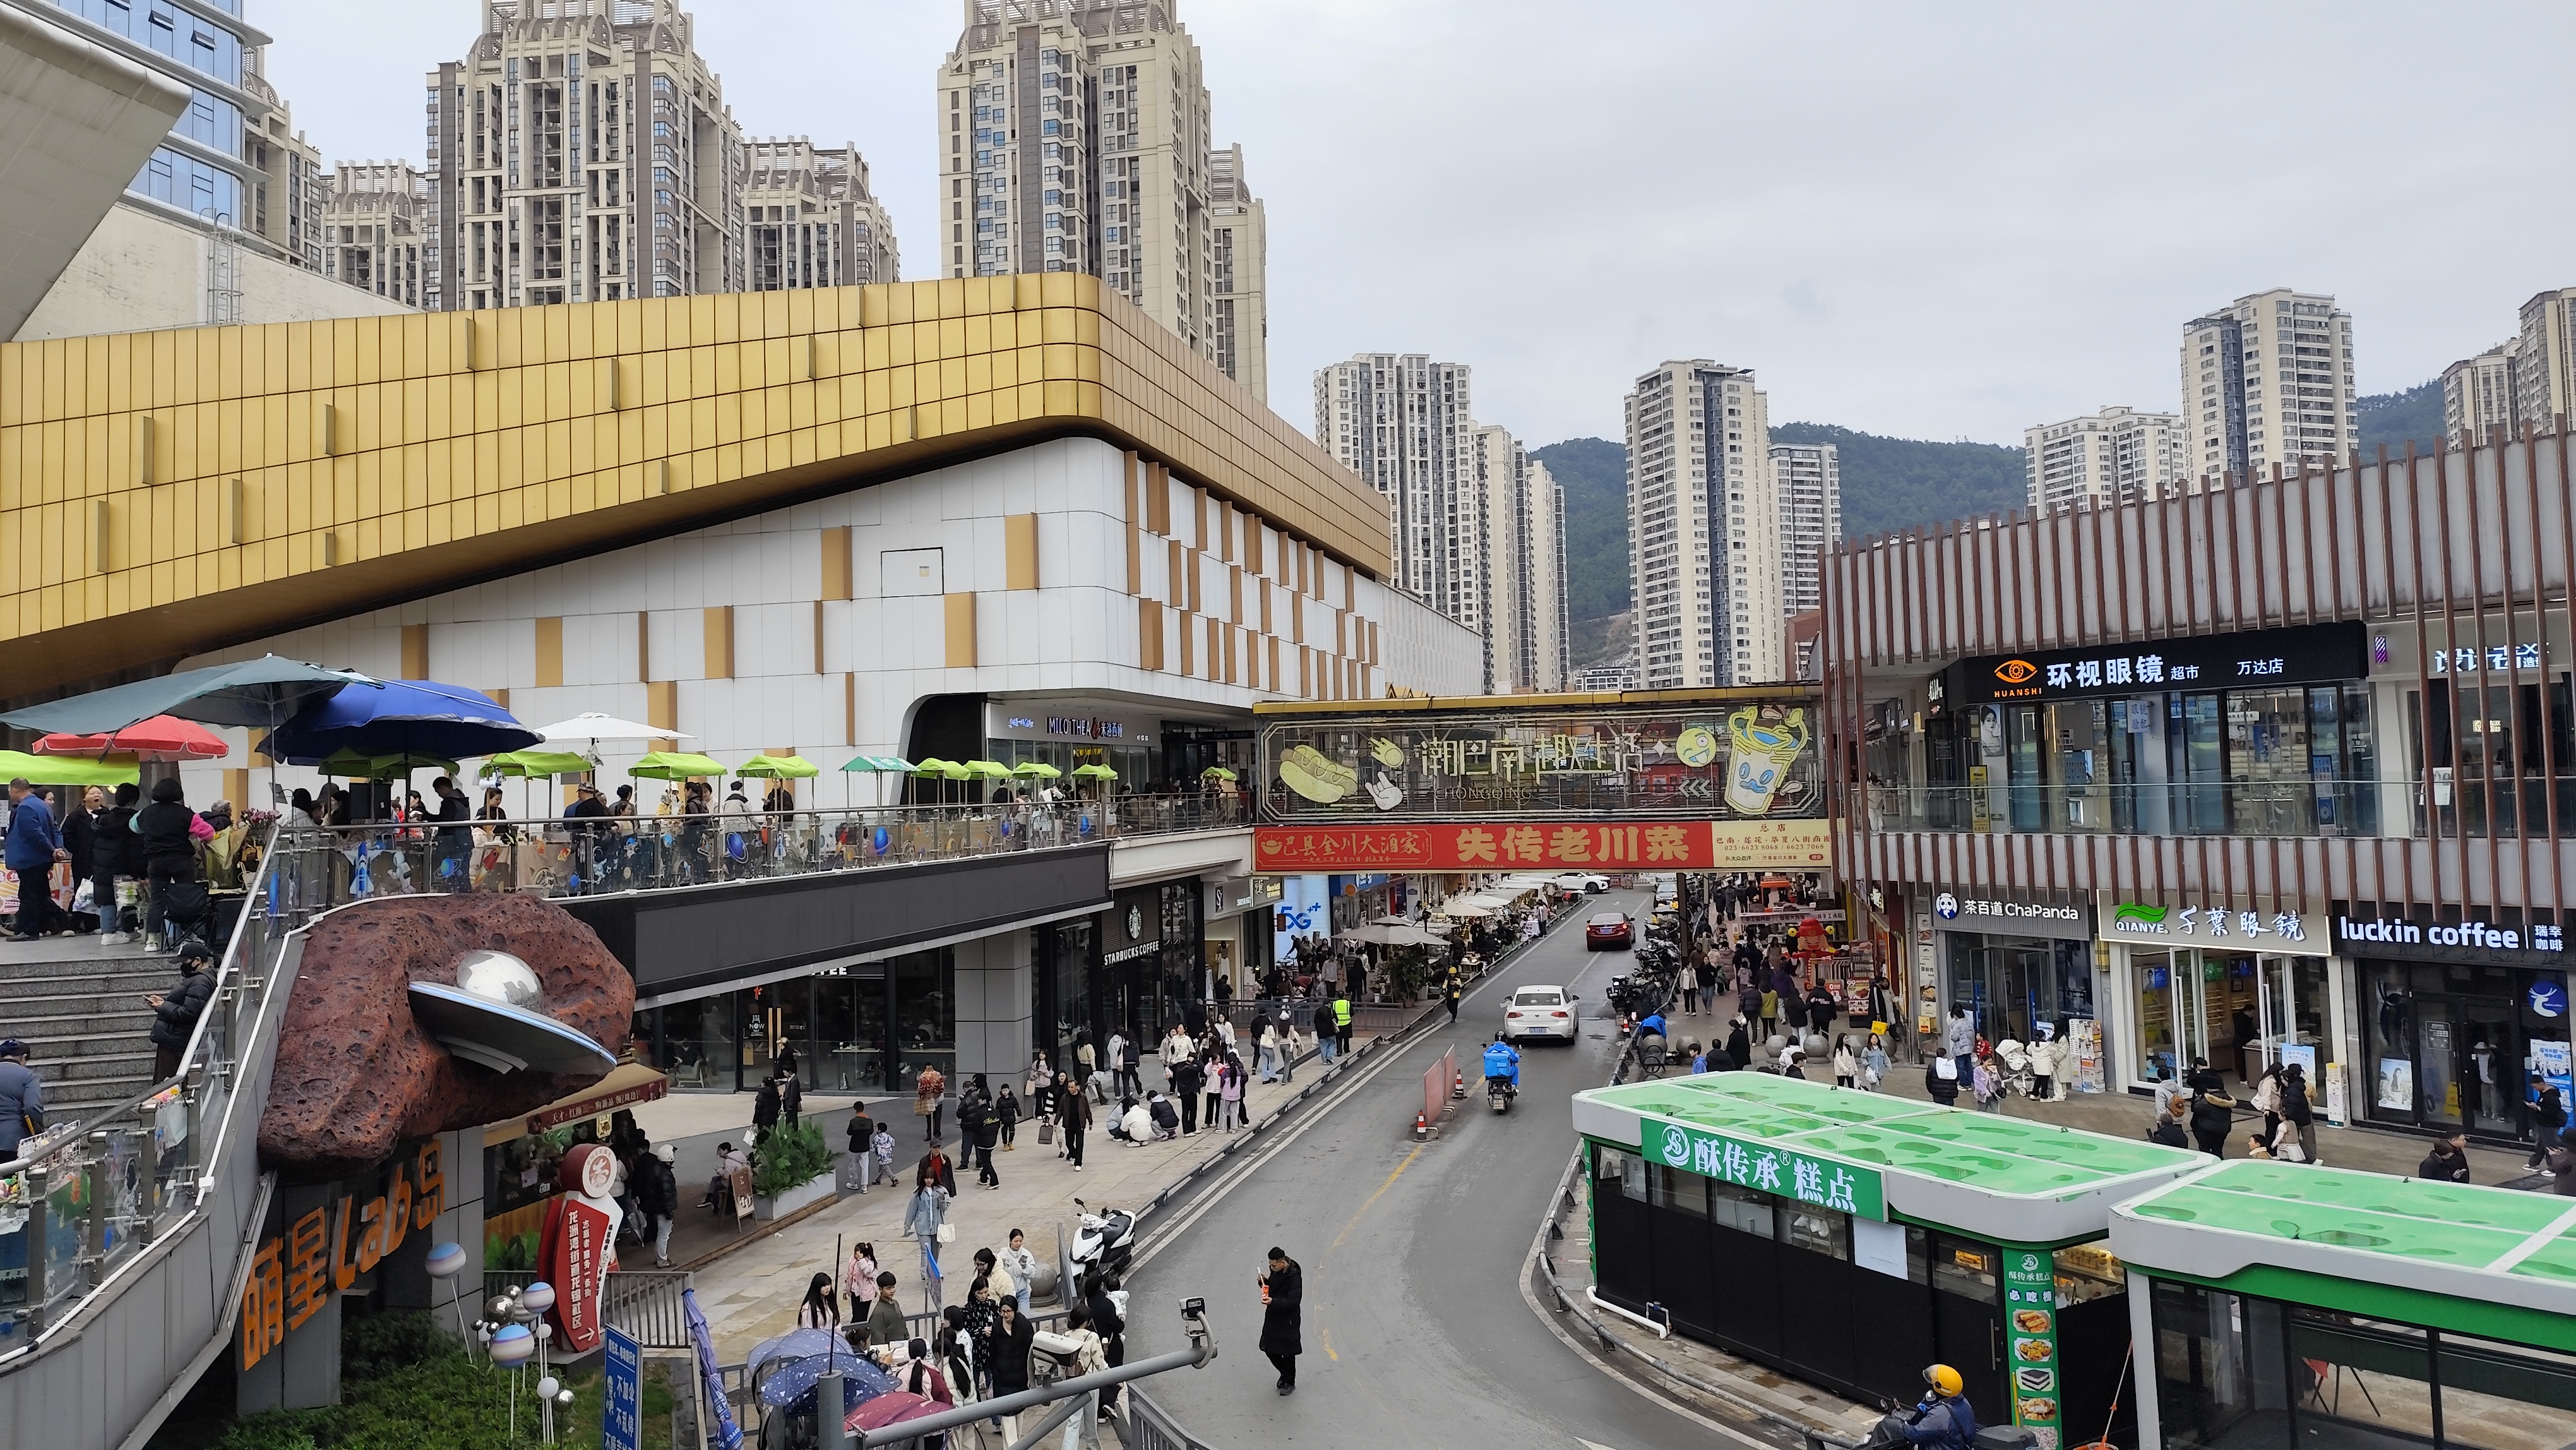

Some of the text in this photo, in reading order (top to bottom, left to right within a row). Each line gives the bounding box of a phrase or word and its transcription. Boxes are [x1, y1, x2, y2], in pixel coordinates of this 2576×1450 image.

[2046, 654, 2284, 689] 环视眼镜 超市 万达店
[1995, 687, 2042, 697] HUANSHI
[1421, 731, 1643, 785] 潮巴南趣生活
[1434, 787, 1532, 800] CHONGQING
[1760, 824, 1786, 832] 总店
[1282, 831, 1421, 857] 巴县金川大酒家
[1456, 825, 1690, 863] 失传老川菜
[1964, 899, 2078, 921] 茶百道 ChaPanda
[2340, 916, 2519, 949] luckin coffee
[2534, 925, 2562, 938] 瑞幸
[1104, 940, 1159, 966] STARBUCKS COFFEE
[2534, 938, 2564, 952] 咖啡
[568, 1209, 582, 1329] 龙洲湾街道龙锦社区
